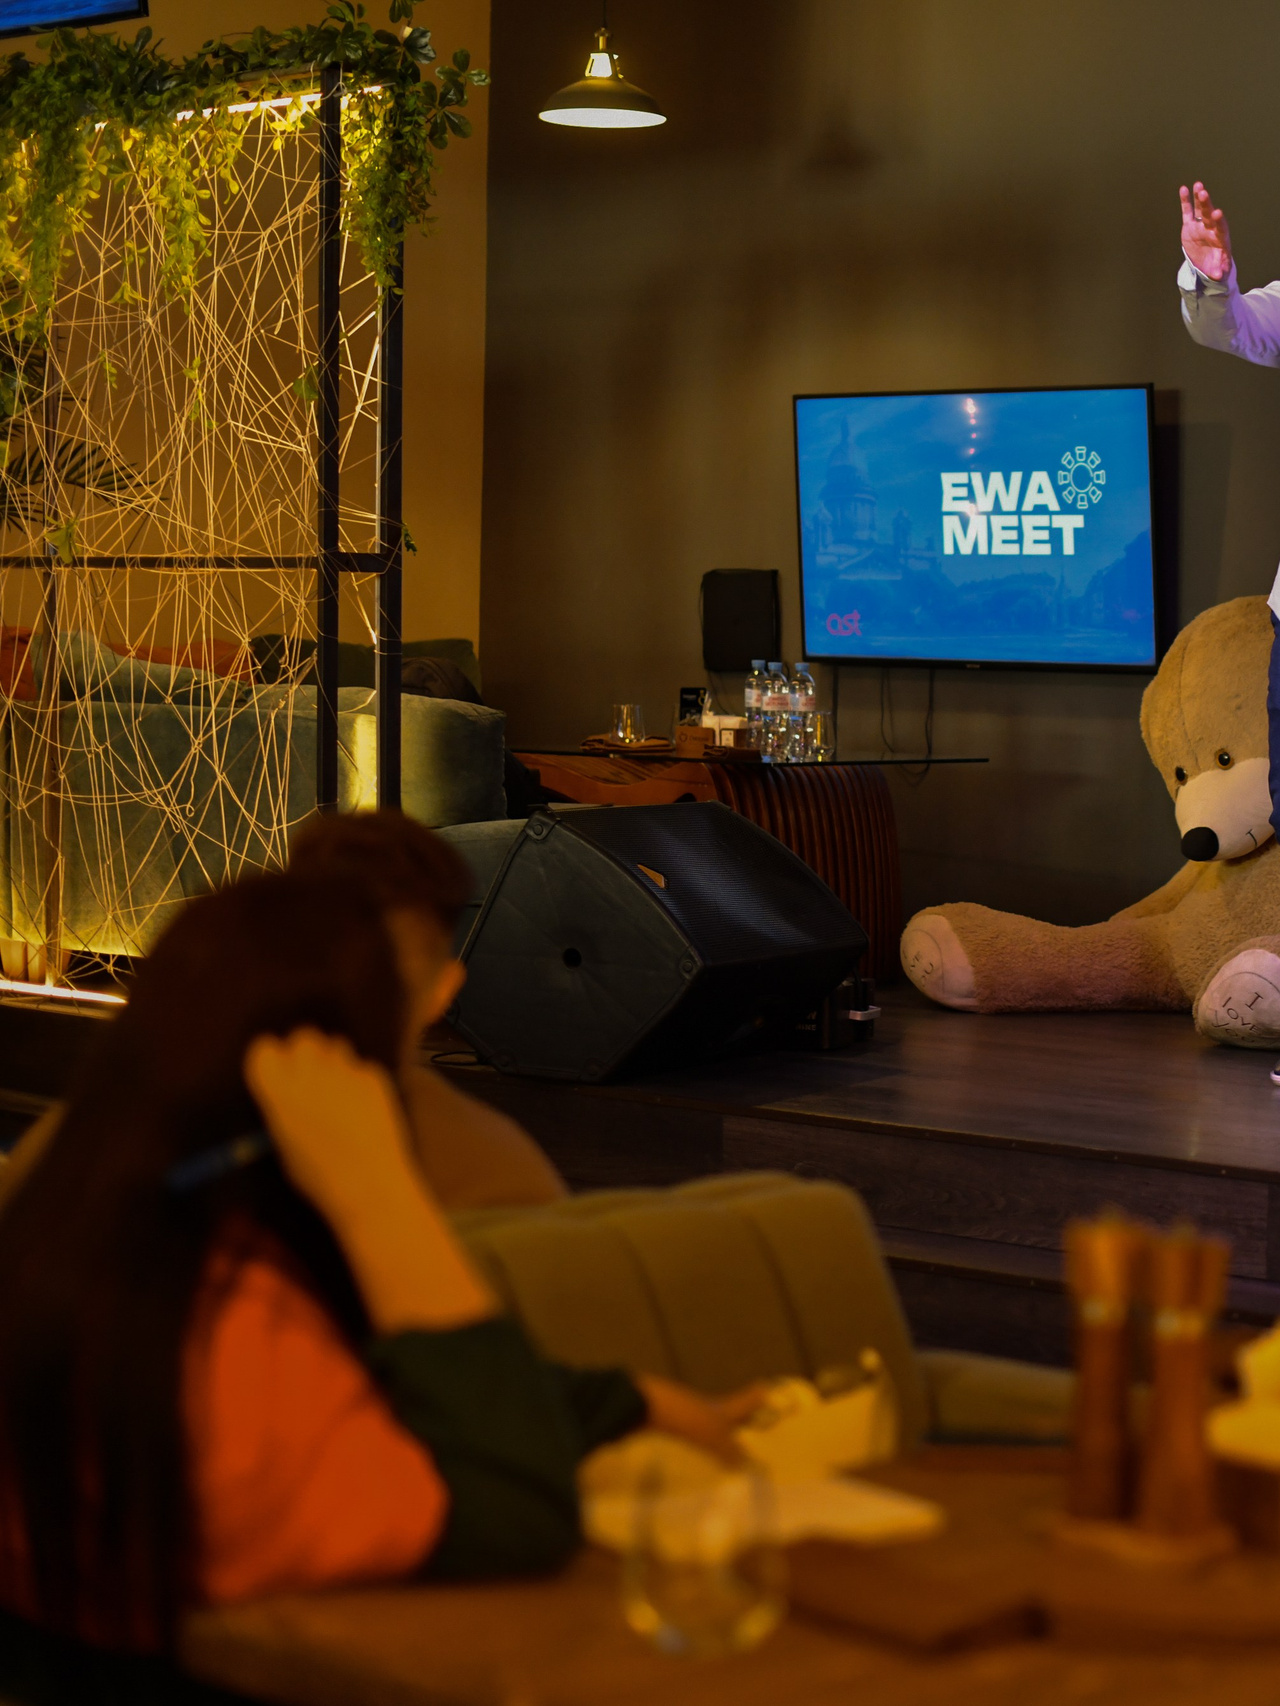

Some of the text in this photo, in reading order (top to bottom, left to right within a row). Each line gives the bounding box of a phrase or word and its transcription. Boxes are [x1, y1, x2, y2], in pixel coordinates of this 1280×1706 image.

[940, 471, 1061, 512] EWA
[942, 514, 1085, 555] MEET
[826, 610, 862, 636] ast
